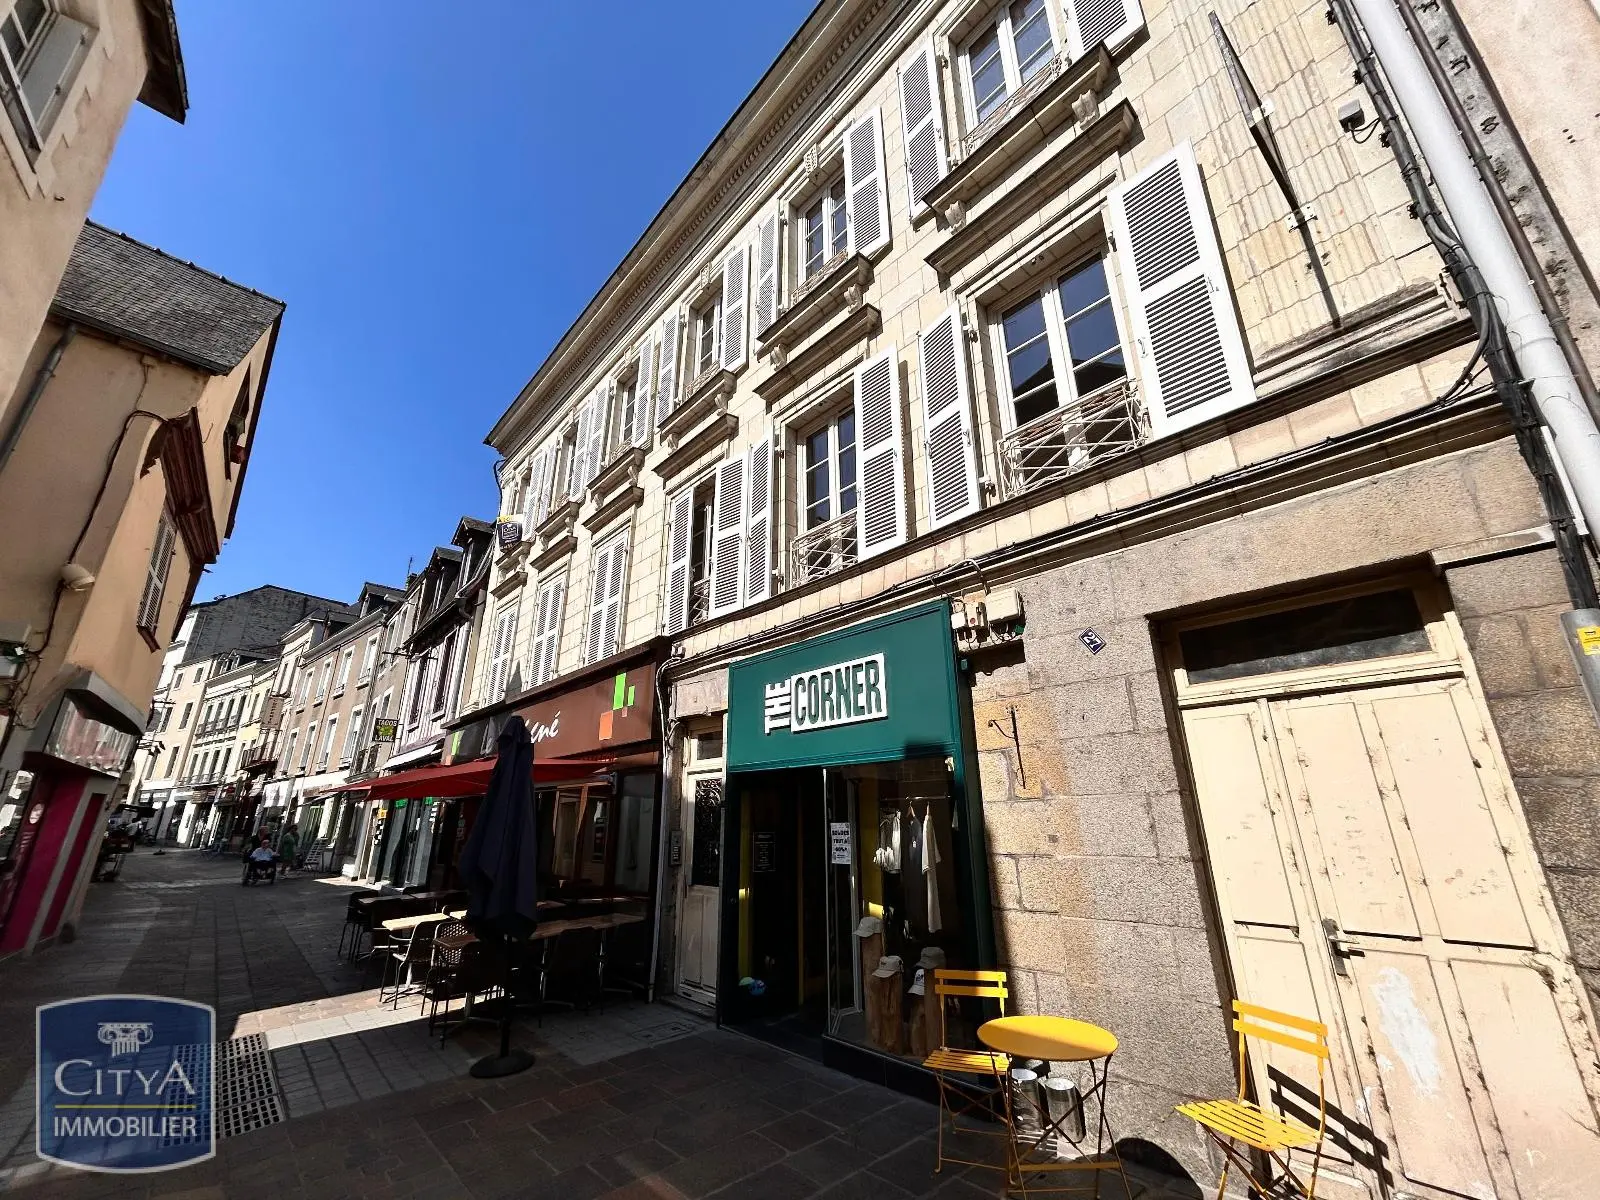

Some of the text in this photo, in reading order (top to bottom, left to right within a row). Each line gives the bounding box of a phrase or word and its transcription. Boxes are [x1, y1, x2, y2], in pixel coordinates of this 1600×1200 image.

[1082, 630, 1102, 649] 27
[764, 659, 883, 734] THE CORNER
[378, 719, 398, 727] TACOS
[374, 734, 394, 742] LAVAL
